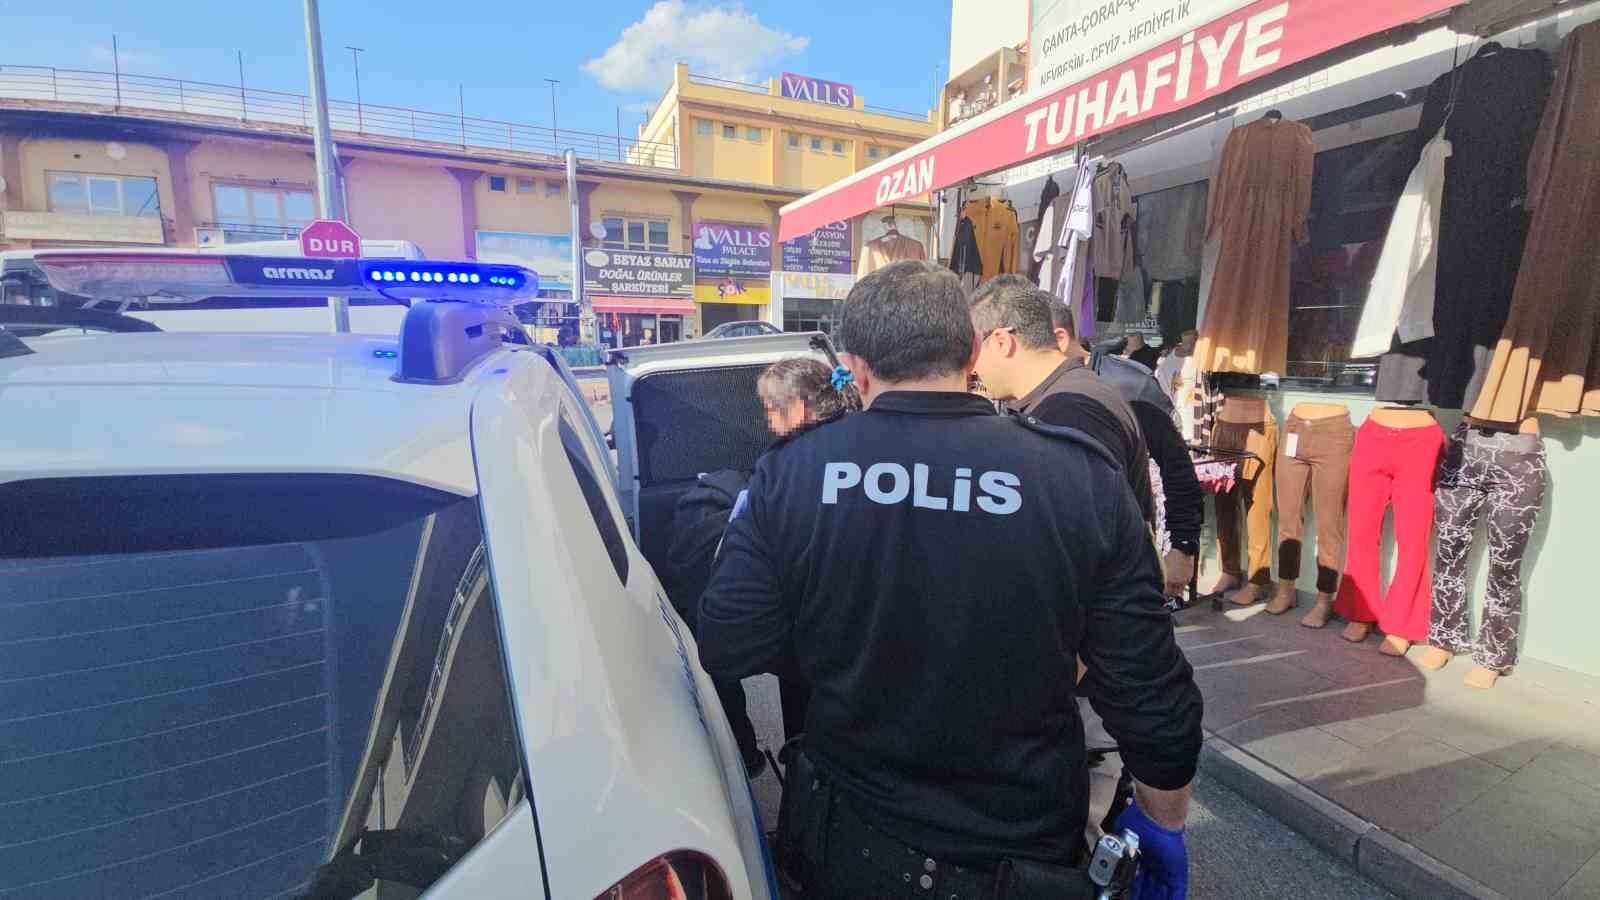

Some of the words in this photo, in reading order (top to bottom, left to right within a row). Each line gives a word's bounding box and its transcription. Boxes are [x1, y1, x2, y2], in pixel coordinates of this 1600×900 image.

[1024, 2, 1289, 153] TUHAFİYE
[785, 77, 849, 107] VALLS
[876, 155, 935, 206] OZAN
[708, 227, 770, 247] VALLS
[310, 238, 354, 253] DUR
[722, 246, 757, 256] PALACE
[613, 255, 651, 266] BEYAZ
[654, 256, 691, 268] SARAY
[263, 267, 335, 280] armas
[599, 268, 635, 280] DOĞAL
[637, 270, 683, 282] ÜRÜNLER
[611, 282, 669, 294] ŞARKÜTERİ
